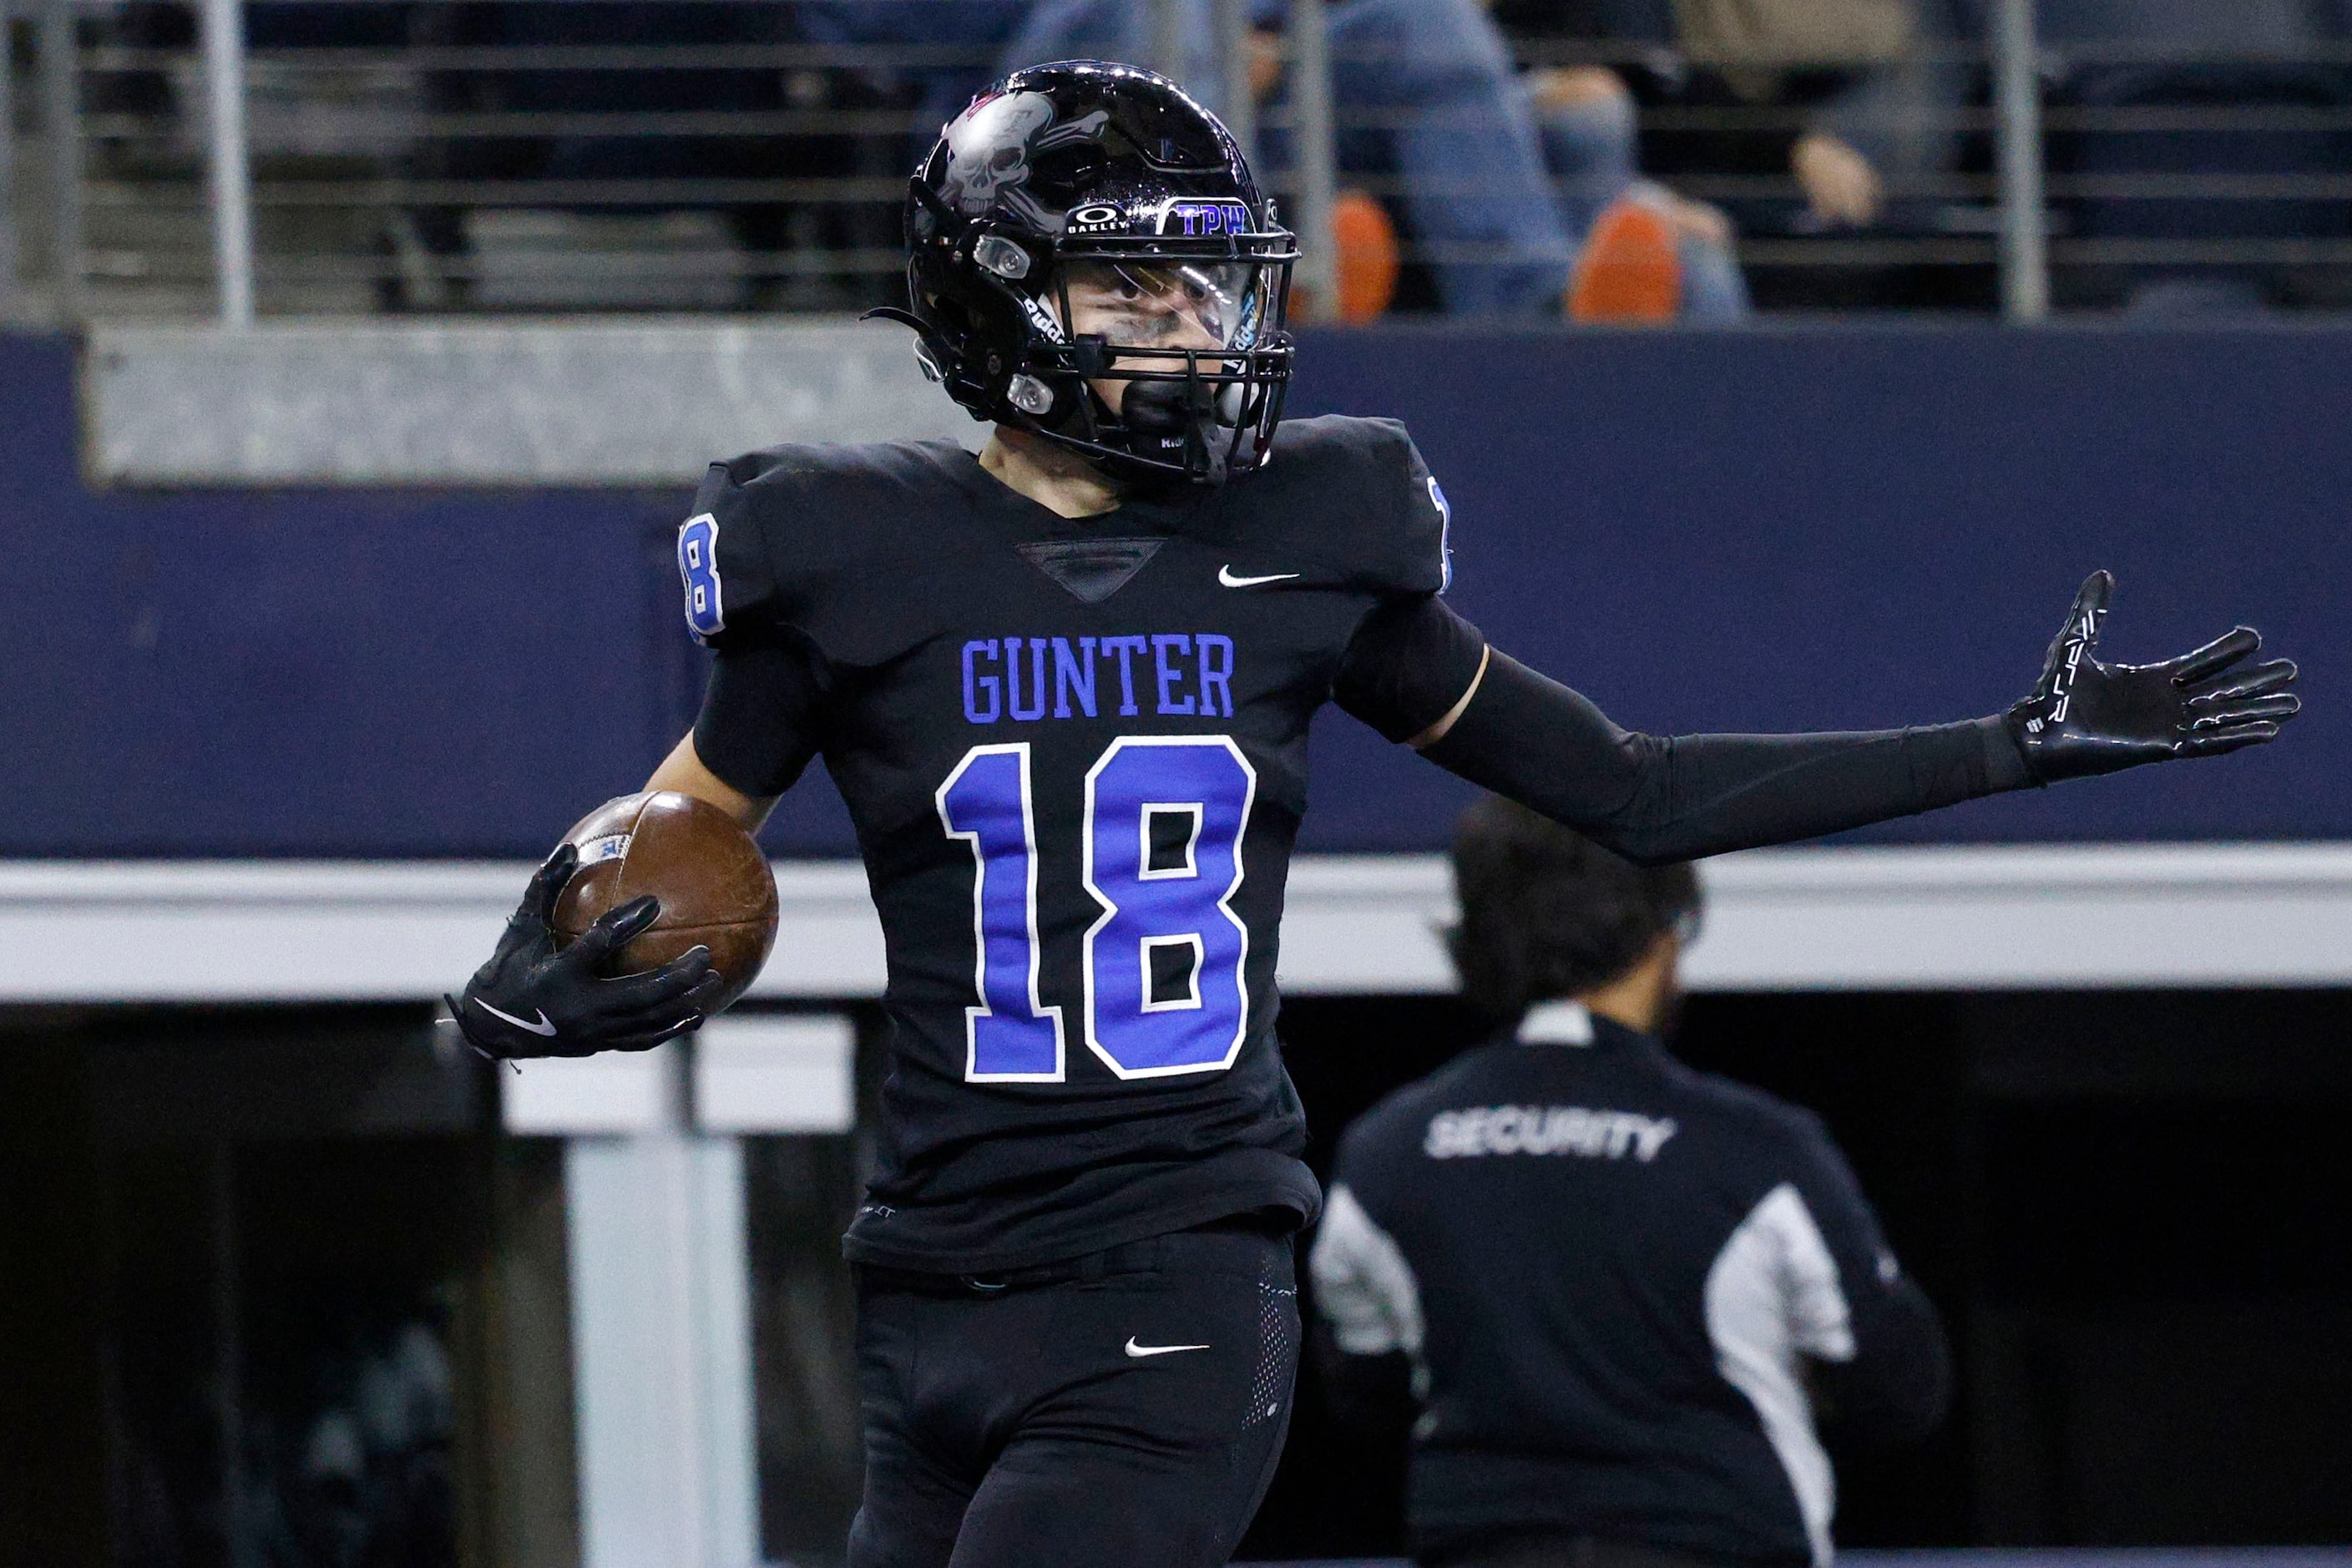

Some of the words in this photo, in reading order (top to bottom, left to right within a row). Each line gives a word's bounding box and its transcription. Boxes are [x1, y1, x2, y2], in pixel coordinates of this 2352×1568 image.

[1068, 221, 1128, 234] OAKLEY
[1176, 205, 1245, 235] TPW
[961, 634, 1235, 724] GUNTER
[934, 735, 1257, 1083] 18
[1423, 1105, 1678, 1162] SECURITY
